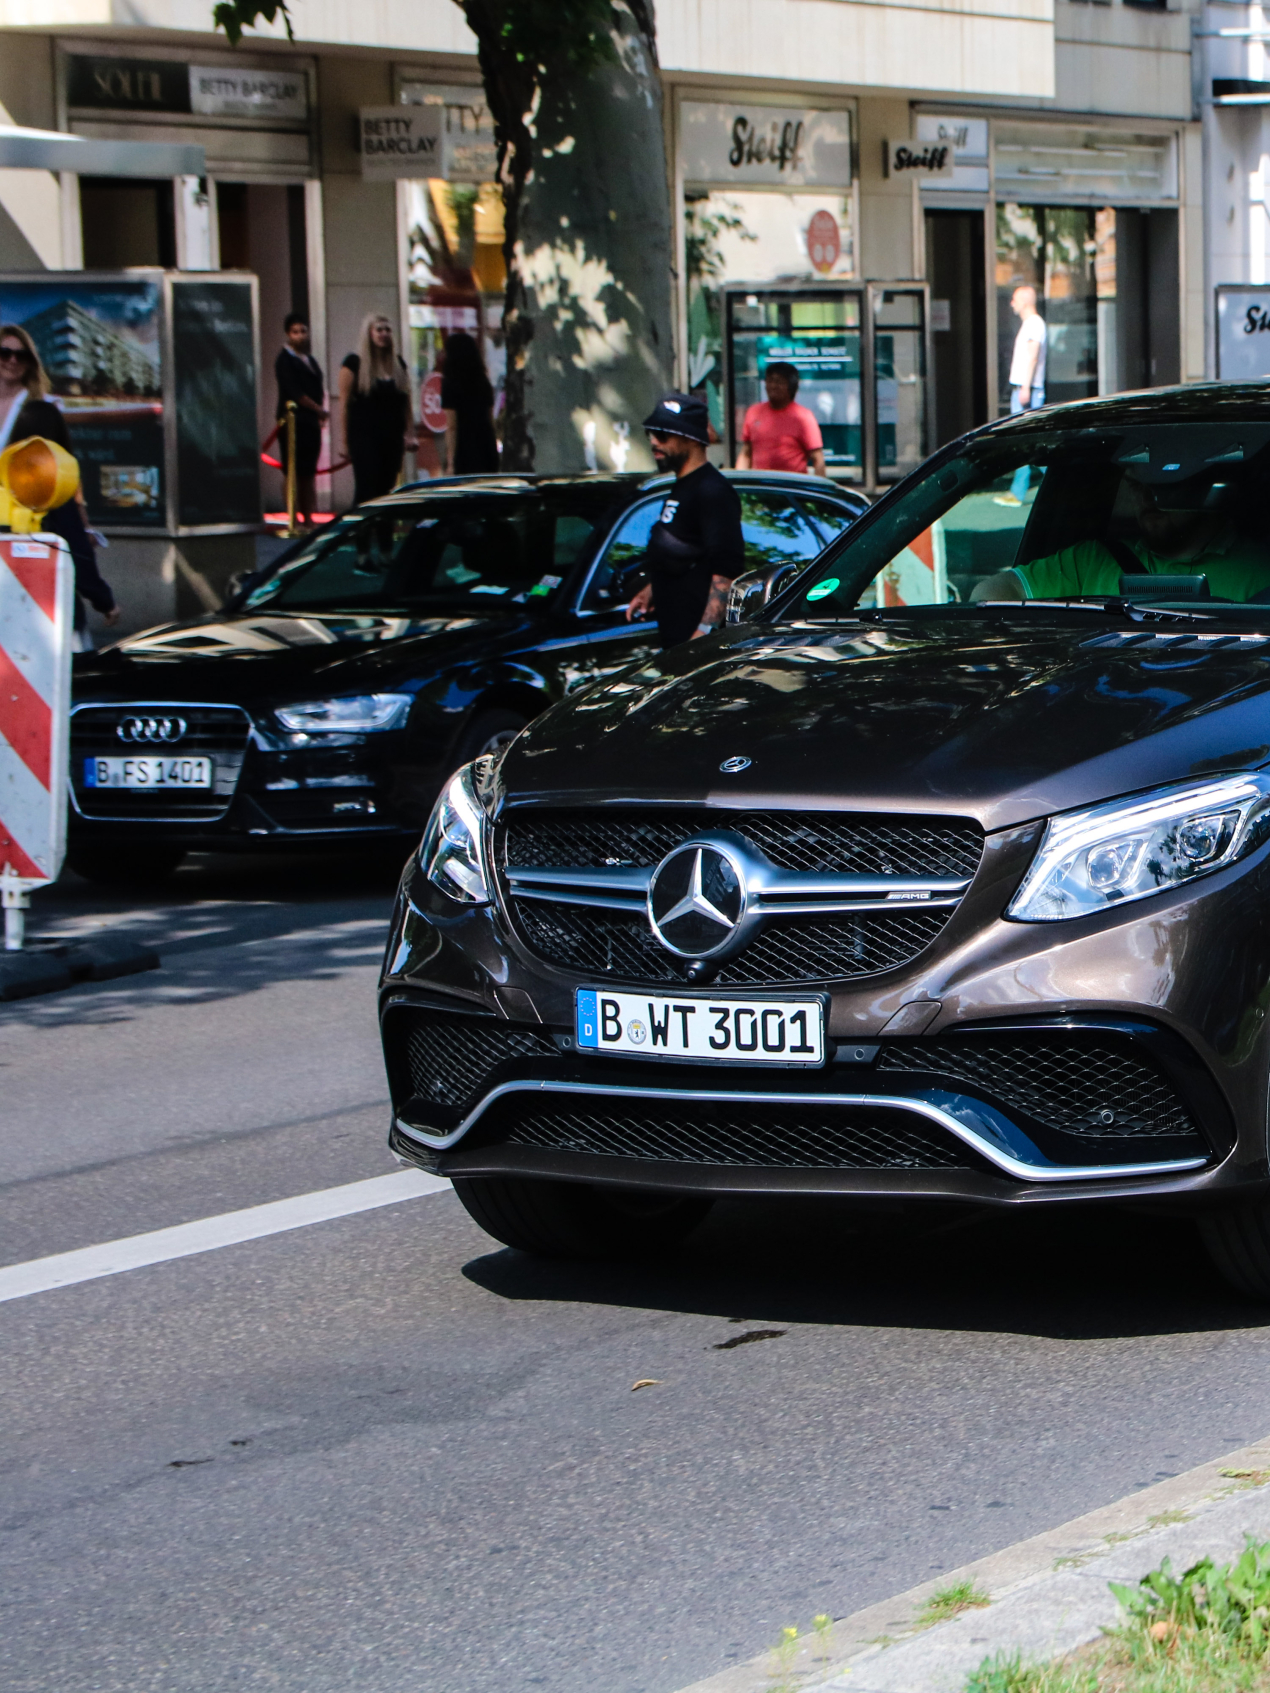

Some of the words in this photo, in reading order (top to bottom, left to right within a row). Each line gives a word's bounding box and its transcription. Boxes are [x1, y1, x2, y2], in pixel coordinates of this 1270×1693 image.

[363, 116, 413, 136] BETTY
[363, 136, 438, 155] BARCLAY
[729, 116, 804, 172] Steiff
[893, 146, 949, 172] Steiff
[97, 761, 109, 784] B
[123, 761, 149, 784] FS
[155, 761, 206, 784] 1401
[584, 1023, 593, 1037] D
[601, 998, 623, 1042] B
[648, 1003, 697, 1049] WT
[708, 1006, 816, 1054] 3001
